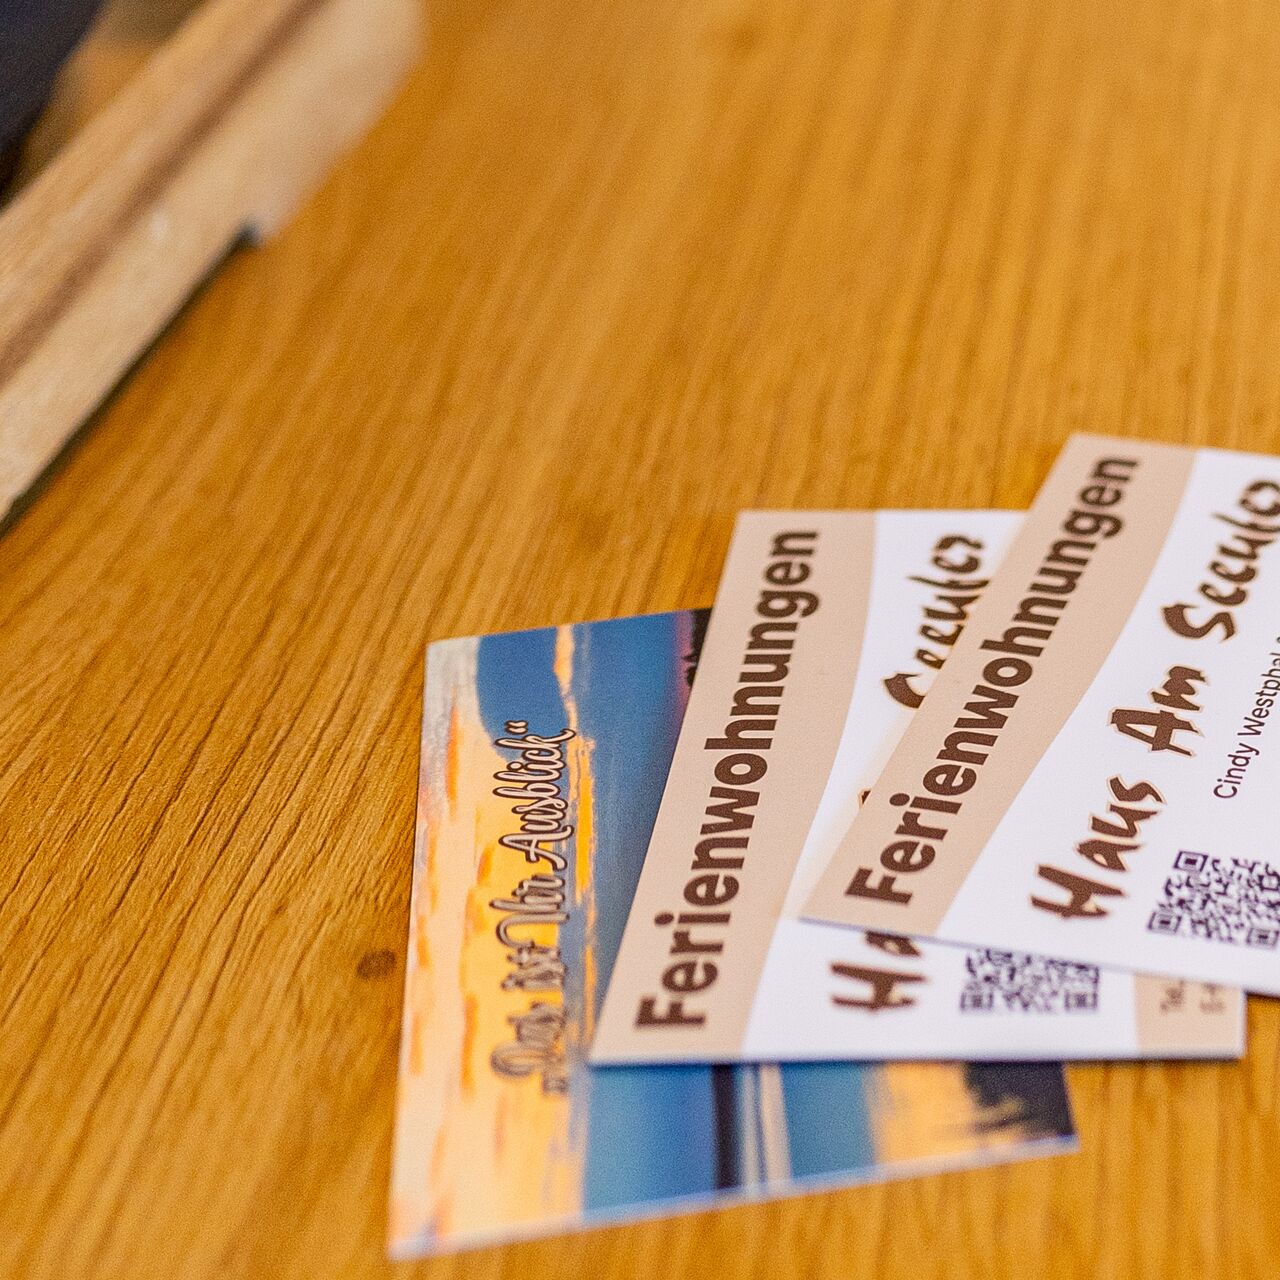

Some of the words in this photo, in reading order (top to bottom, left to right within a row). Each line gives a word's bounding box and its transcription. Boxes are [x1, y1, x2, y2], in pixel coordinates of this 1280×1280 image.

[845, 456, 1139, 904] Ferienwohnungen
[634, 530, 820, 1029] Ferienwohnungen
[1030, 776, 1165, 920] Haus
[1109, 664, 1205, 756] Am
[1213, 742, 1259, 798] Cindy
[489, 874, 569, 947] Ihr
[830, 930, 928, 1012] Ha
